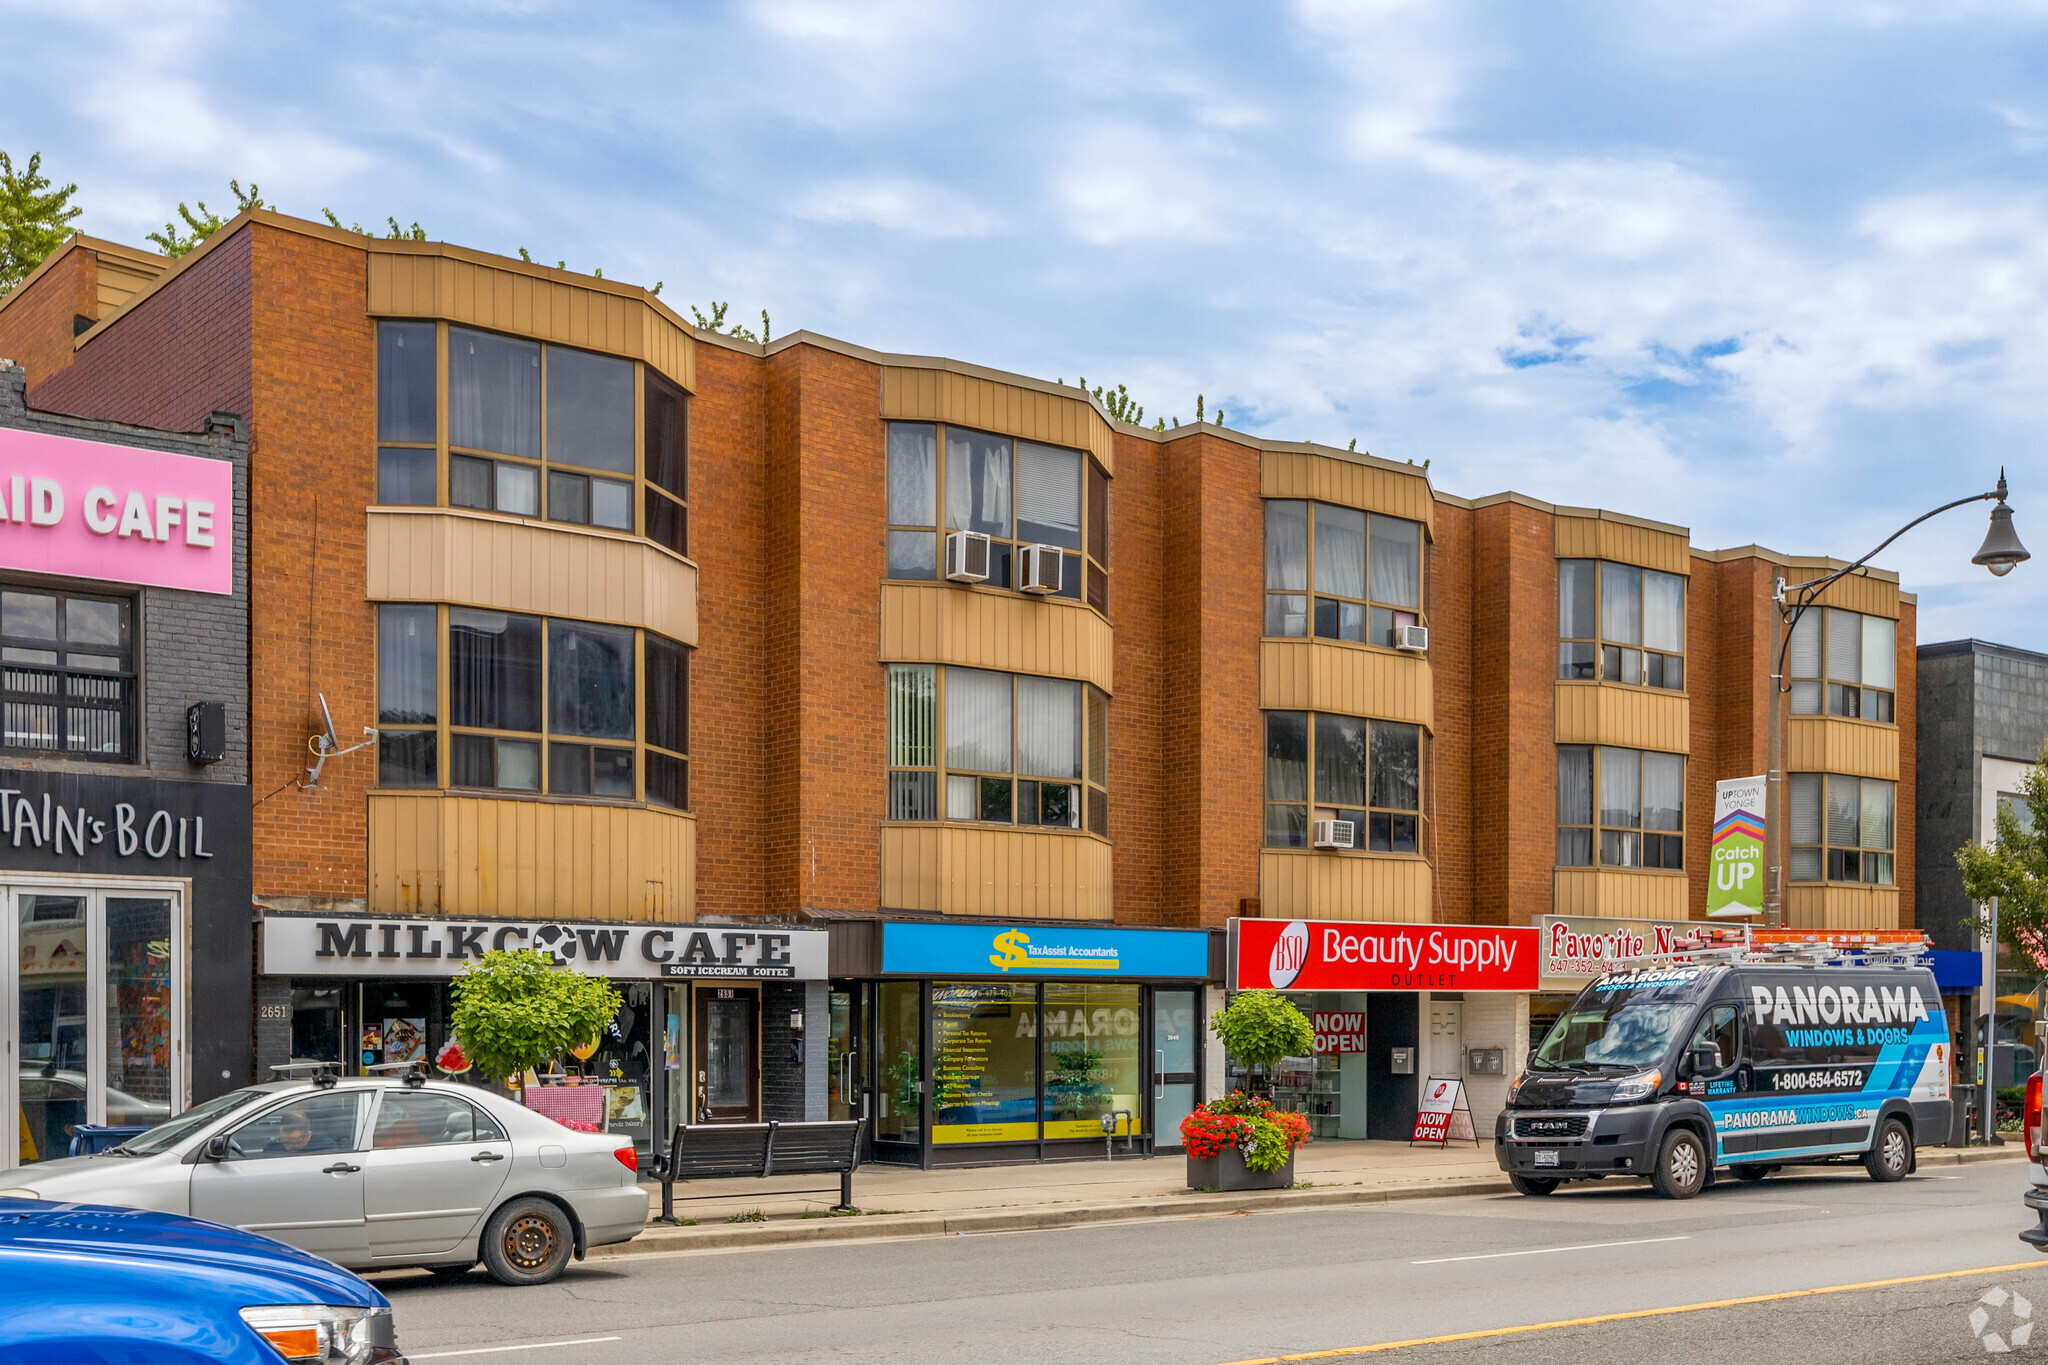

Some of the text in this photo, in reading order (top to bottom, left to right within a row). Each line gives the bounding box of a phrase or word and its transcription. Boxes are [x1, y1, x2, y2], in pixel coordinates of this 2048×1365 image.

[83, 486, 215, 548] CAFE
[1722, 788, 1759, 799] UPTOWN
[1724, 798, 1755, 809] YONGE
[115, 803, 214, 858] BOIL
[1715, 845, 1759, 860] Catch
[1717, 862, 1755, 891] UP
[641, 930, 791, 964] CAFE
[1550, 922, 1643, 959] Favorite
[1027, 945, 1118, 957] TaxAssist Accountants
[1323, 929, 1517, 972] Beauty Supply
[670, 966, 789, 977] SOFT ICECREAM COFFEE
[1391, 974, 1455, 986] OUTLET
[261, 1006, 287, 1018] 2651
[1751, 985, 1929, 1025] PANORAMA
[1315, 1013, 1362, 1032] NOW
[1313, 1034, 1364, 1052] OPEN
[1785, 1027, 1909, 1047] WINDOWS & DOORS
[1709, 1080, 1734, 1089] LIFETIME
[1772, 1070, 1862, 1090] 1-800-654-6572
[1707, 1086, 1736, 1095] WARRANTY
[1419, 1112, 1446, 1126] NOW
[1724, 1104, 1868, 1130] PANORAMAWINDOWS.CA
[1414, 1126, 1445, 1140] OPEN
